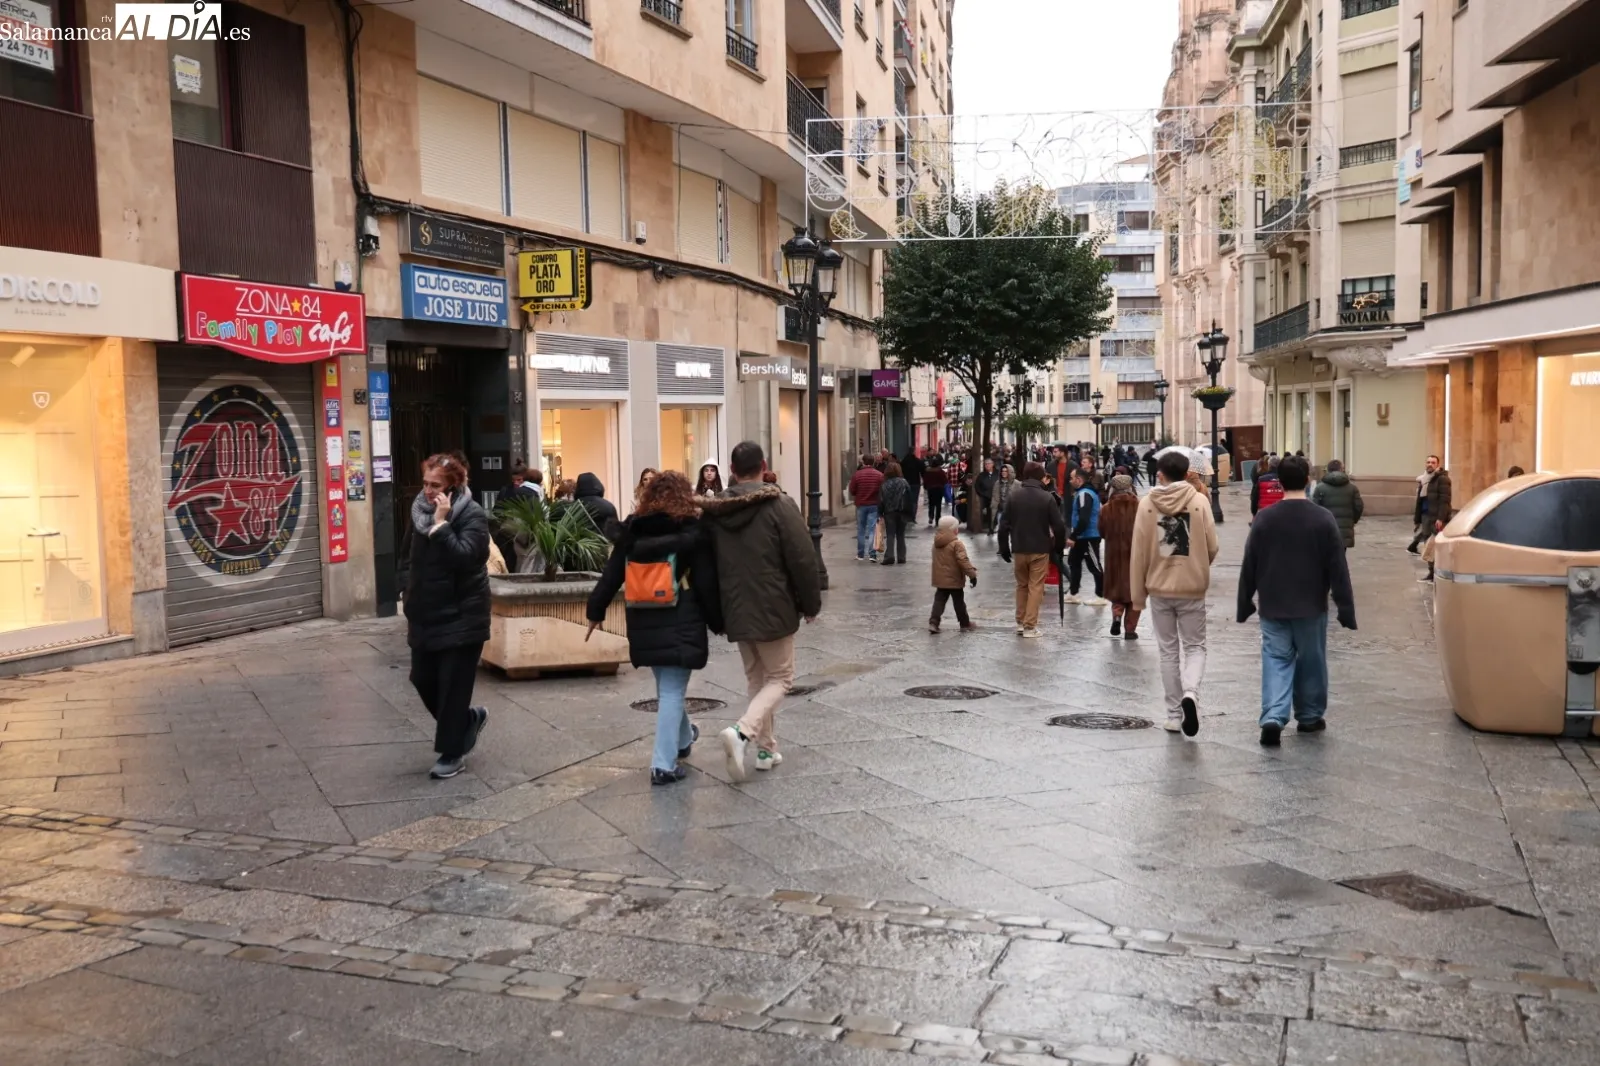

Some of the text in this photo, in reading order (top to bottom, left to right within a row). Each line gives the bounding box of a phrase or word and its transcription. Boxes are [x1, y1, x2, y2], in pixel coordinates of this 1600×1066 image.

[7, 40, 20, 52] 24
[22, 44, 34, 56] 79
[37, 48, 49, 60] 71
[531, 253, 558, 264] COMPRO
[529, 264, 561, 279] PLATA
[536, 280, 555, 294] ORO
[235, 287, 321, 318] ZONA 84
[424, 296, 498, 322] JOSE LUIS
[196, 311, 258, 346] Family
[264, 320, 302, 347] Play
[742, 363, 788, 375] Bershka
[873, 379, 899, 388] GAME
[168, 421, 286, 506] Zona
[249, 486, 279, 540] 84
